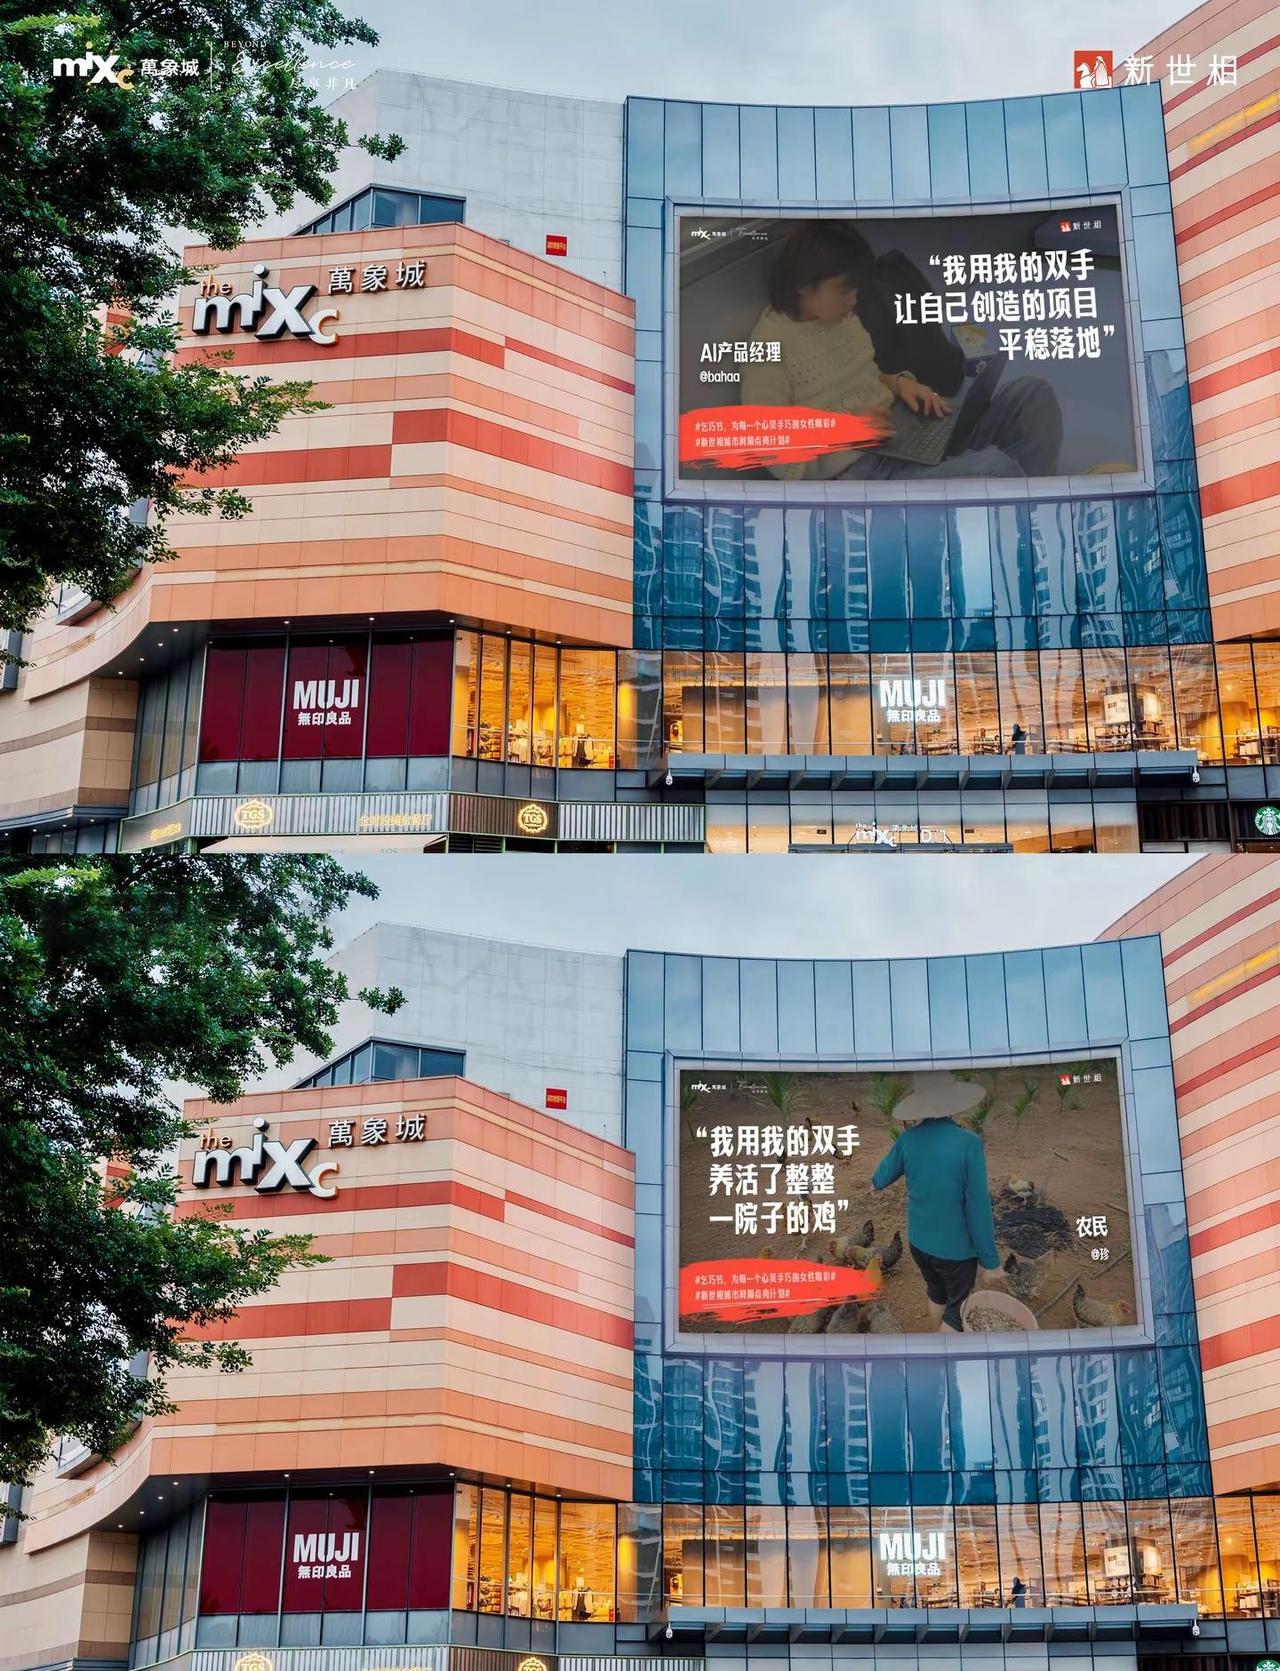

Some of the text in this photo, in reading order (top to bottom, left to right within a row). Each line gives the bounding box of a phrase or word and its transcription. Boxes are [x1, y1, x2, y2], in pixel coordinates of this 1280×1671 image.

[327, 259, 427, 295] 萬象城
[929, 248, 1095, 285] “我用我的双手
[200, 275, 233, 296] the
[894, 287, 1098, 325] 让自己创造的项目
[700, 341, 782, 363] AI产品经理
[998, 325, 1115, 360] 平稳落地”
[700, 371, 740, 383] @bahaa
[293, 679, 360, 709] MUJI
[880, 680, 946, 707] MUJI
[298, 711, 351, 726] 無印良品
[886, 708, 941, 723] 無印良品
[240, 809, 265, 820] TGS
[523, 813, 542, 824] TGS
[200, 1129, 233, 1150] the
[327, 1113, 427, 1149] 萬象城
[696, 1124, 861, 1157] “我用我的双手
[708, 1163, 835, 1196] 养活了整整
[709, 1199, 849, 1235] 一院子的鸡”
[1075, 1216, 1108, 1238] 农民
[1091, 1247, 1110, 1261] @珍
[293, 1532, 360, 1562] MUJI
[880, 1532, 946, 1560] MUJI
[298, 1564, 351, 1579] 無印良品
[886, 1562, 941, 1576] 無印良品
